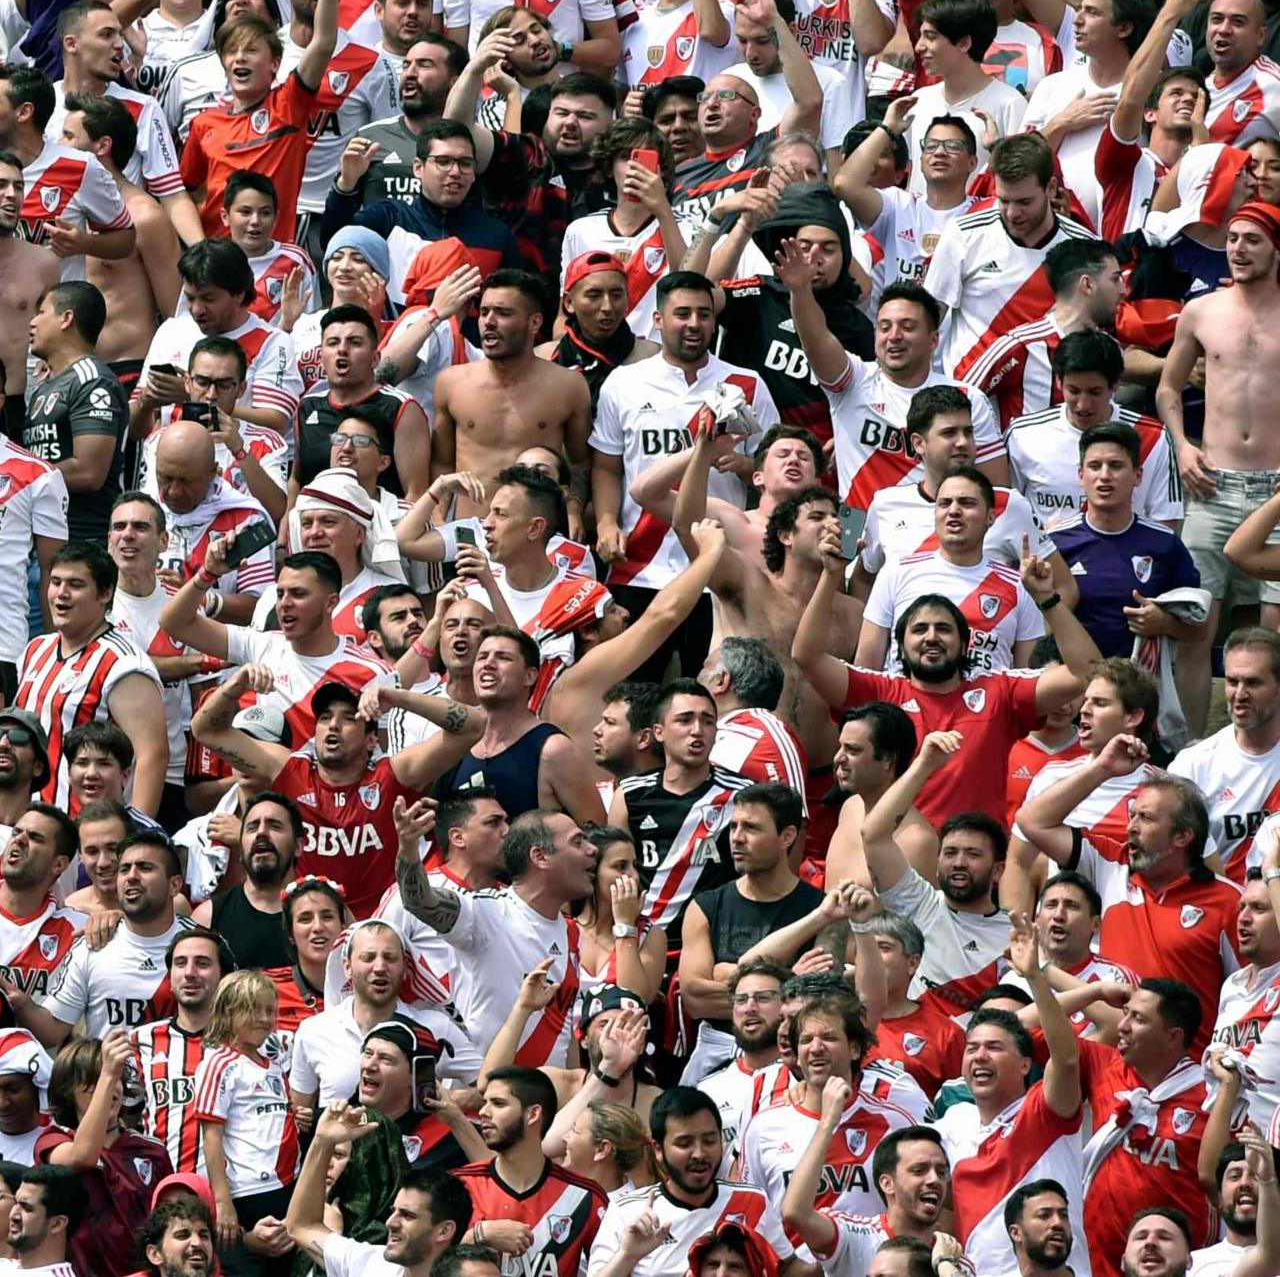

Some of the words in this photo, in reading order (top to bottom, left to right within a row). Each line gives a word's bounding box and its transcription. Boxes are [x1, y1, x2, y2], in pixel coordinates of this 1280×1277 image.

[151, 117, 174, 169] NETSHOES
[1036, 490, 1074, 508] BBVA
[333, 792, 346, 807] 16
